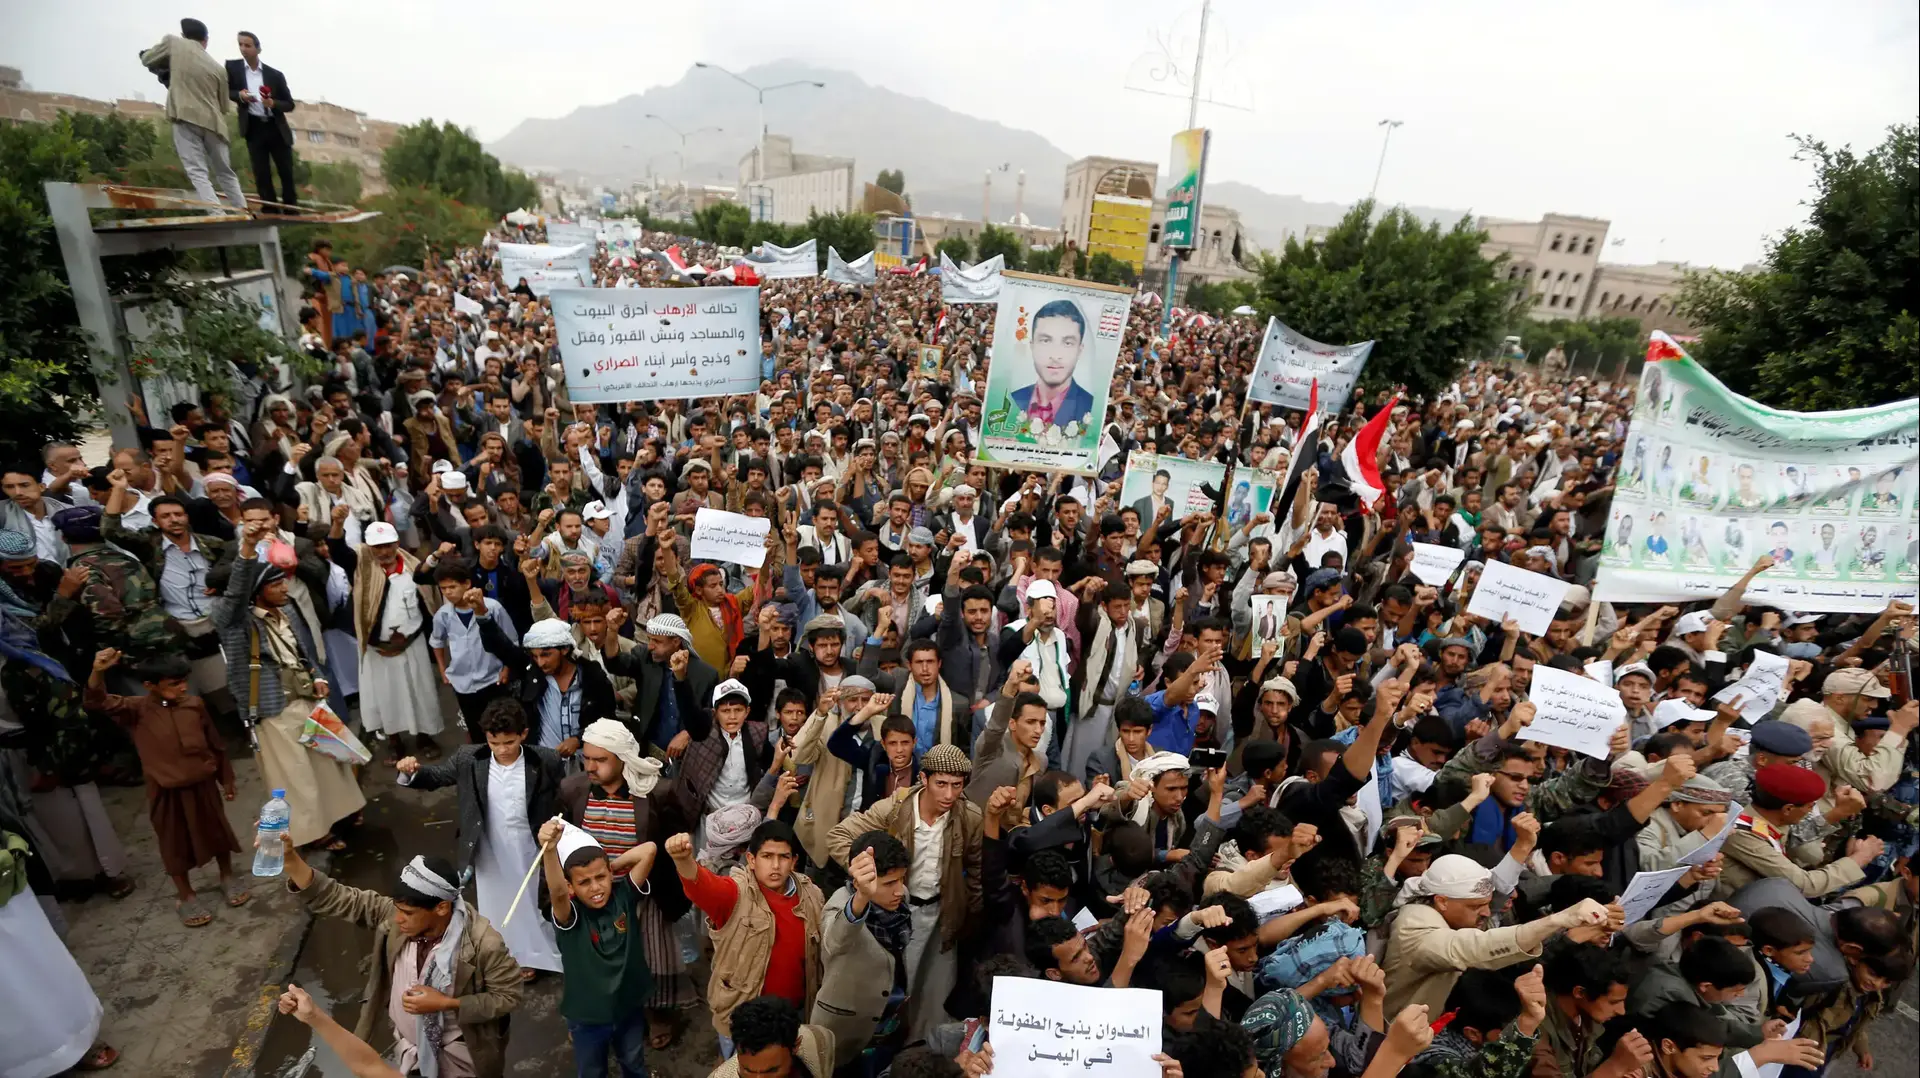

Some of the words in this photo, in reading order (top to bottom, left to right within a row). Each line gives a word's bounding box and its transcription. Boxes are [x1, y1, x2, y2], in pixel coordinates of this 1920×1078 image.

[574, 304, 615, 320] البيوت
[621, 302, 648, 319] أحرق
[702, 302, 737, 315] تحالف
[572, 332, 604, 346] وقتل
[609, 329, 645, 346] القبور
[650, 328, 684, 344] ونبش
[690, 328, 745, 342] والمساجد
[594, 356, 638, 374] الصراري
[644, 352, 665, 368] أبناء
[670, 351, 696, 368] وأسر
[702, 352, 731, 367] وذبح
[1480, 587, 1500, 598] اليمن
[1500, 592, 1510, 600] في
[997, 1009, 1052, 1032] الطفولة
[1054, 1020, 1092, 1040] يذبح
[1096, 1023, 1150, 1041] العدوان
[1028, 1044, 1080, 1066] اليمن
[1084, 1047, 1113, 1070] في
